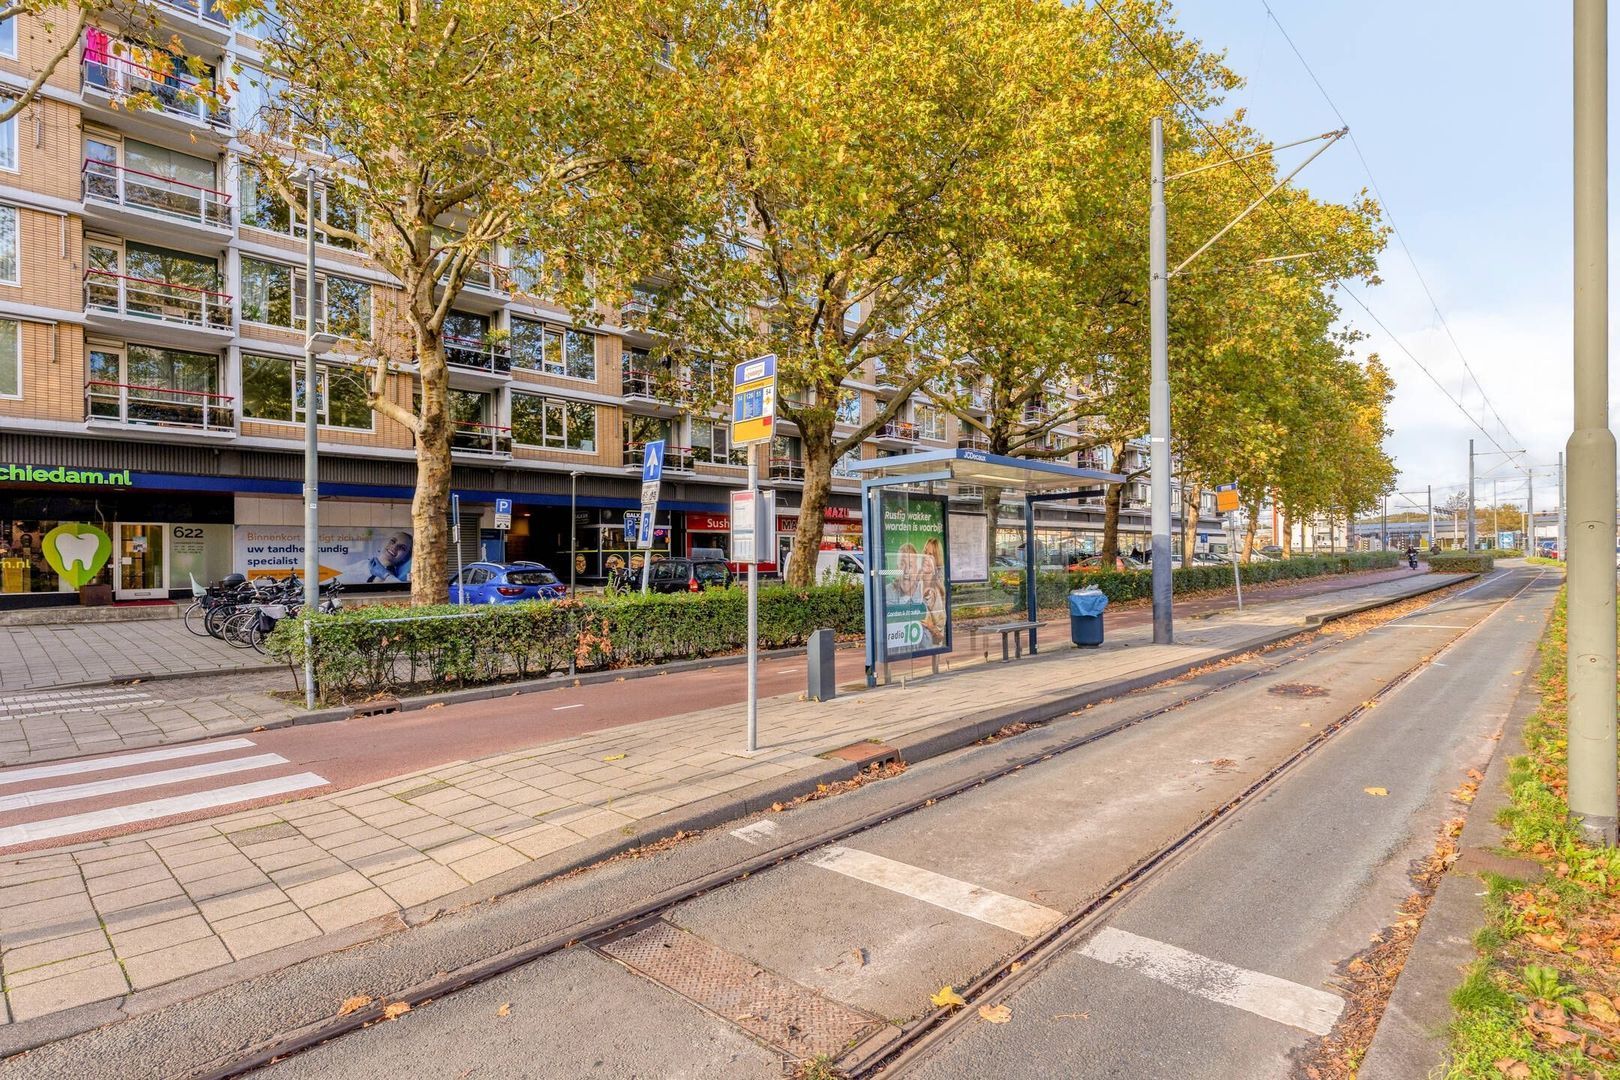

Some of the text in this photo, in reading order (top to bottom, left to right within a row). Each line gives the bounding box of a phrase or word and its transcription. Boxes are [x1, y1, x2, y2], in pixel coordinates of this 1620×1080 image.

[963, 451, 987, 462] JCDecaux
[500, 501, 509, 512] P
[824, 506, 850, 518] MAZU
[885, 511, 932, 522] Rustig wakker
[626, 519, 634, 530] P
[885, 522, 912, 531] worden
[912, 521, 918, 531] is
[173, 526, 204, 539] 622
[247, 532, 300, 542] Binnenkort
[337, 533, 354, 542] zich
[268, 543, 349, 555] tandheundig
[247, 556, 299, 568] specialist
[888, 622, 921, 644] radio 10
